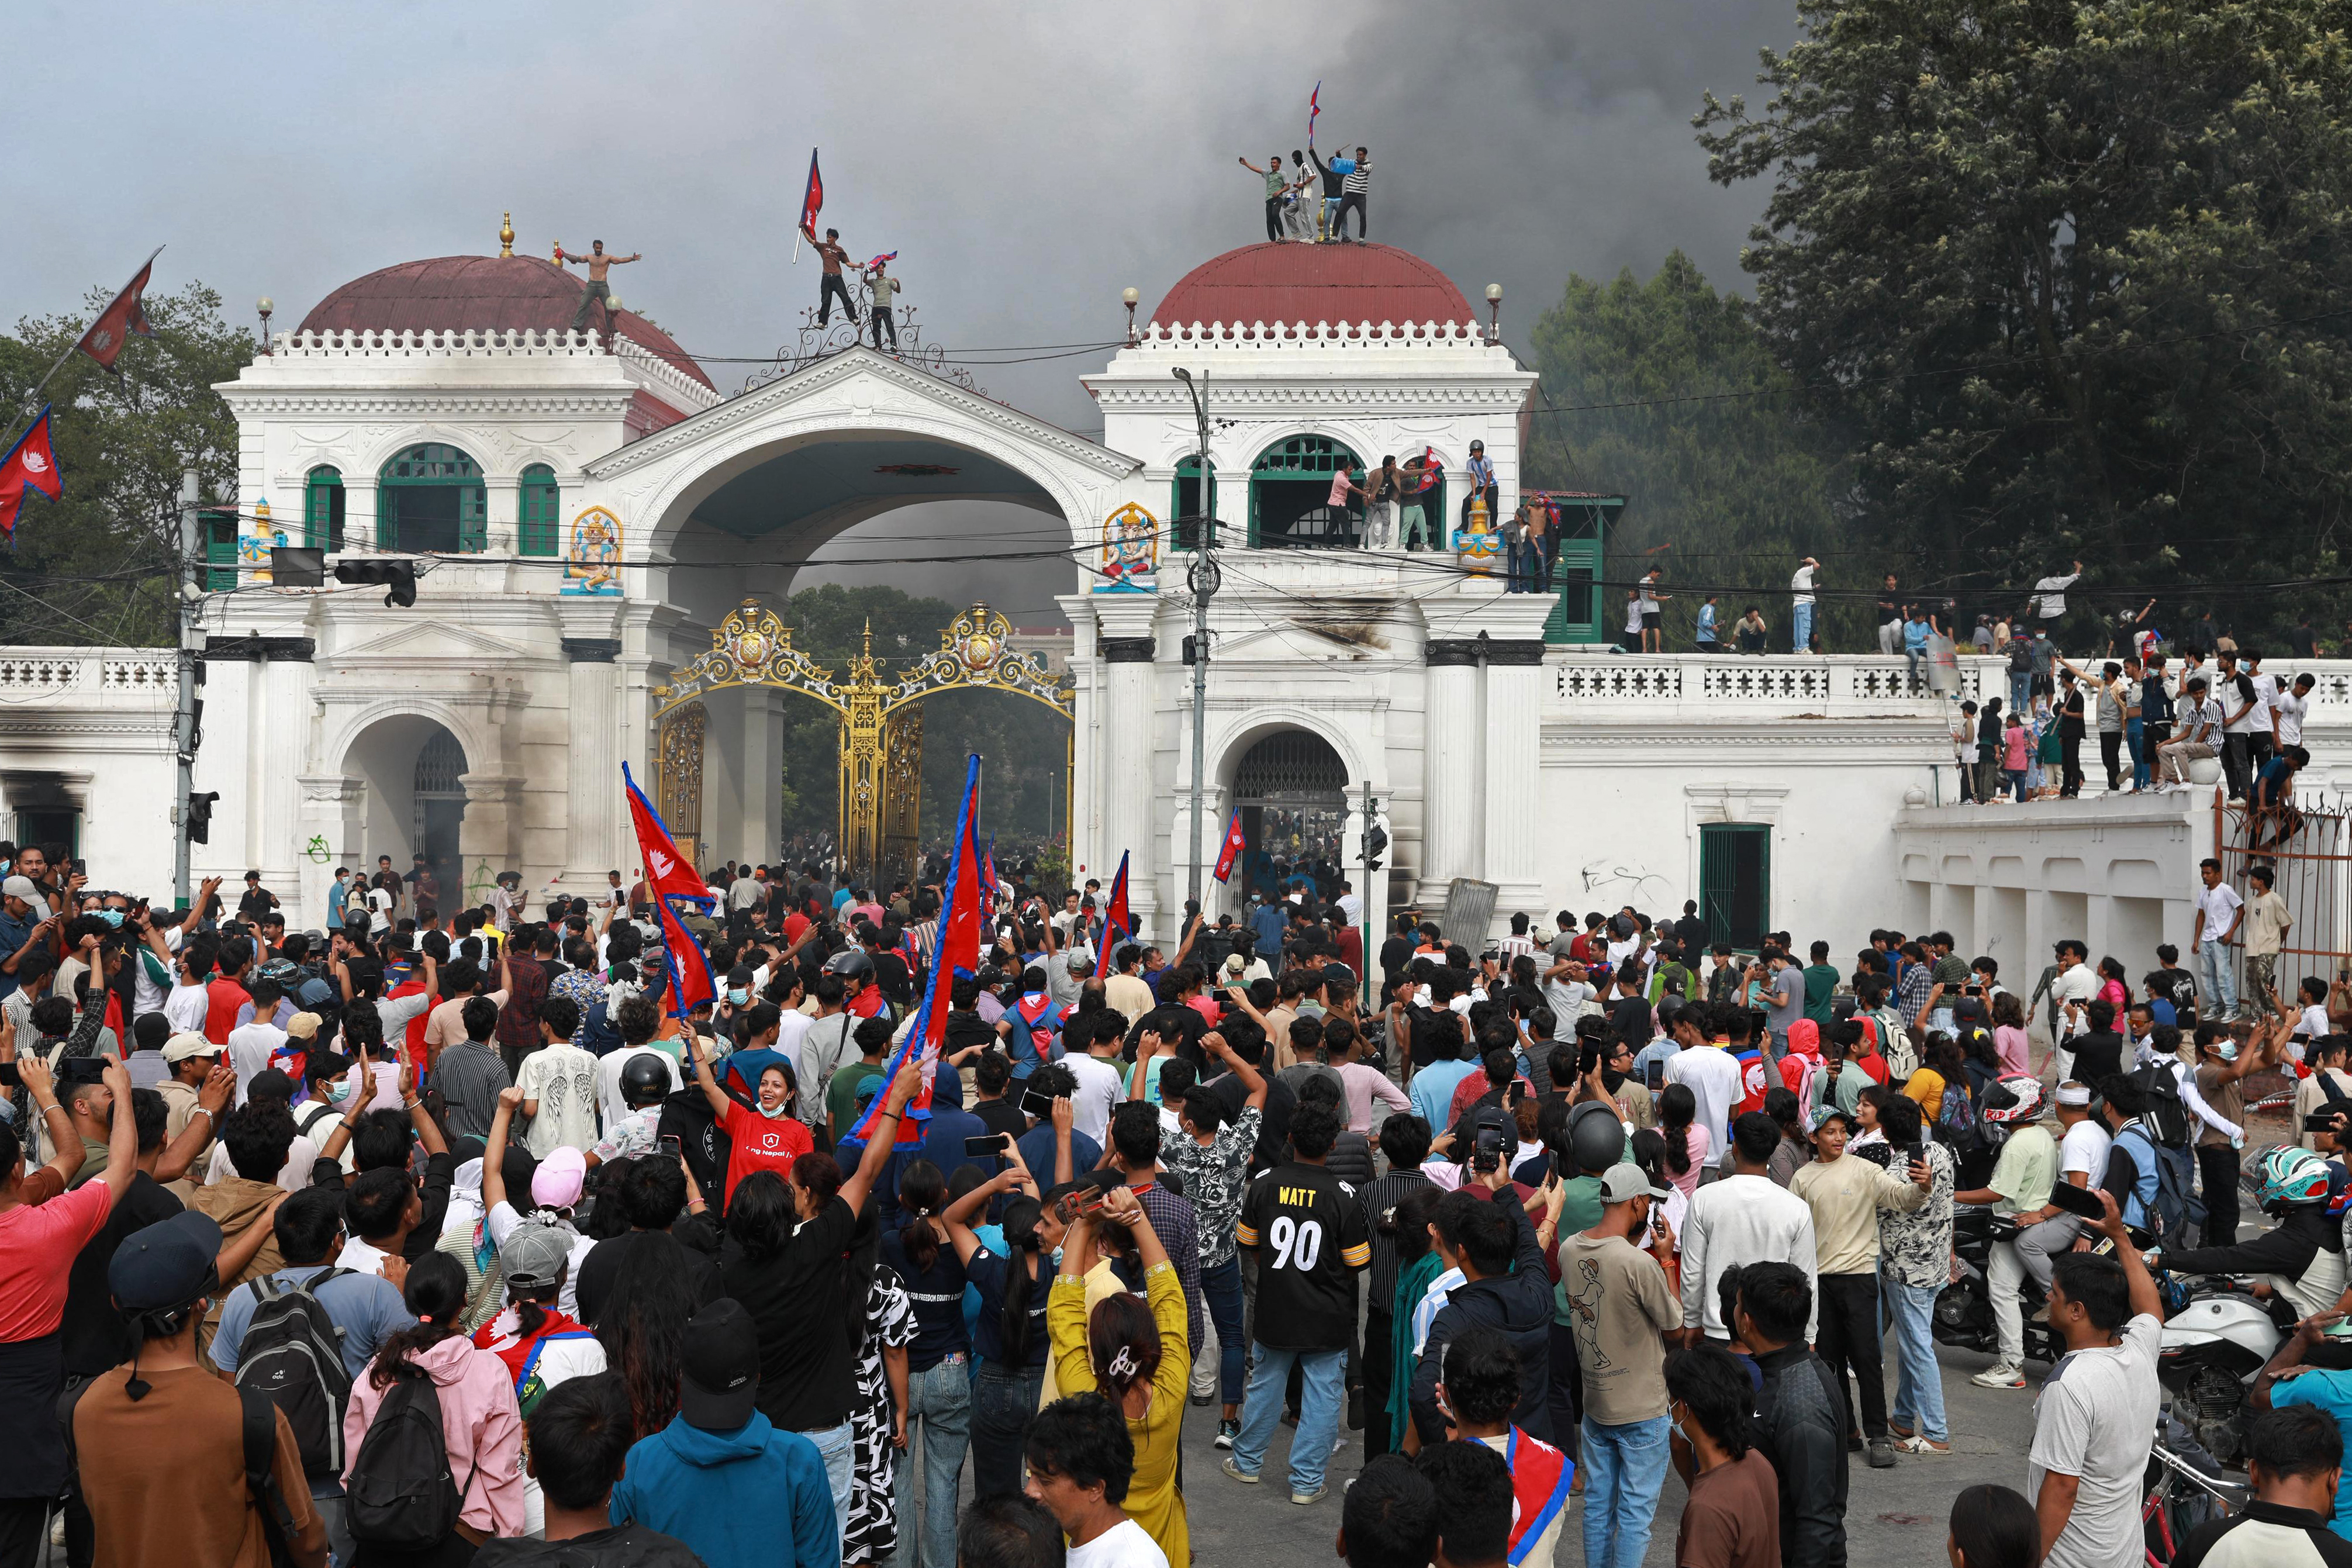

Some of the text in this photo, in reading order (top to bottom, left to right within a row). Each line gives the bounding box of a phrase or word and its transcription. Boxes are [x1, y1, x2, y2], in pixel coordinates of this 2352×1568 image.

[762, 1149, 785, 1158] Nepal
[1279, 1186, 1317, 1207] WATT
[1270, 1215, 1322, 1272] 90
[918, 1293, 936, 1302] FREEDOM
